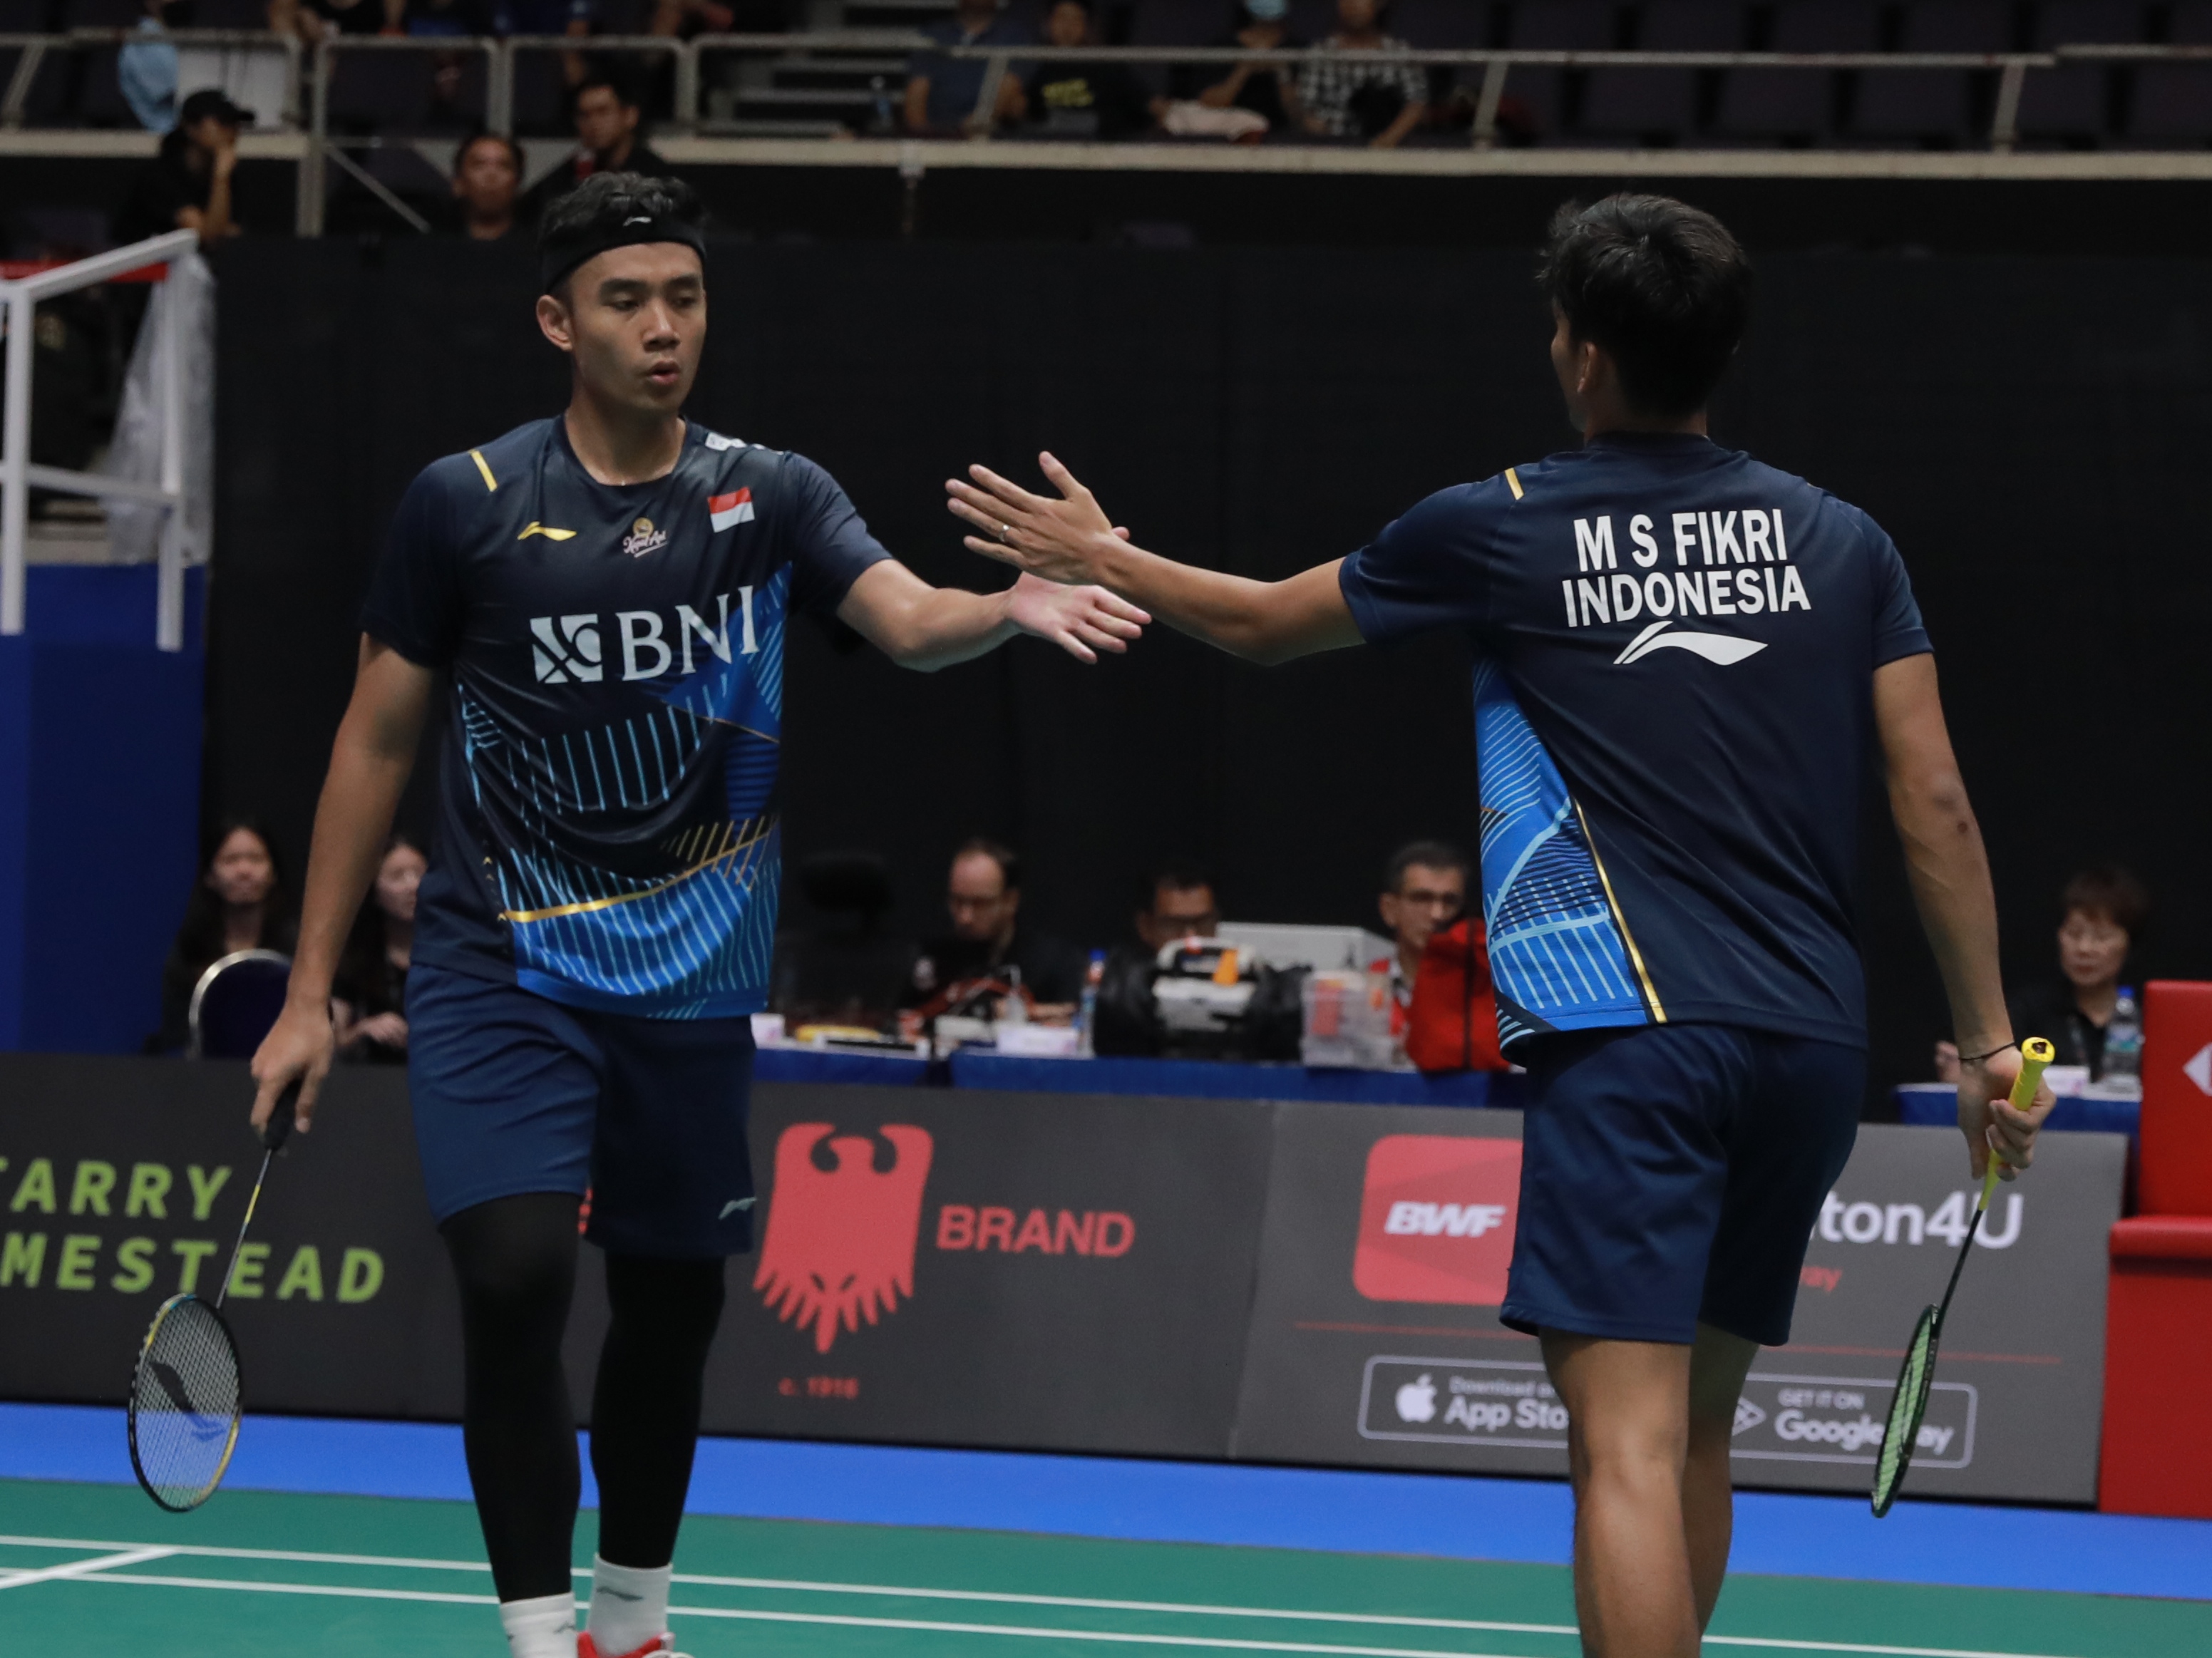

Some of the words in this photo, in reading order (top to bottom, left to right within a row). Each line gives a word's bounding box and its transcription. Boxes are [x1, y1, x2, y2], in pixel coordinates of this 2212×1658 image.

[1573, 515, 1617, 572] M
[1629, 514, 1659, 567] S
[1672, 508, 1788, 566] FIKRI
[1562, 565, 1811, 627] INDONESIA
[614, 585, 761, 681] BNI
[0, 1156, 232, 1220] ARRY
[935, 1205, 1136, 1257] BRAND
[1384, 1200, 1507, 1237] BWF
[1809, 1190, 2025, 1250] ton4U
[0, 1231, 385, 1303] MESTEAD
[1444, 1395, 1512, 1433] App
[1774, 1408, 1886, 1452] Google
[1778, 1389, 1814, 1409] GET
[1832, 1391, 1866, 1411] ON
